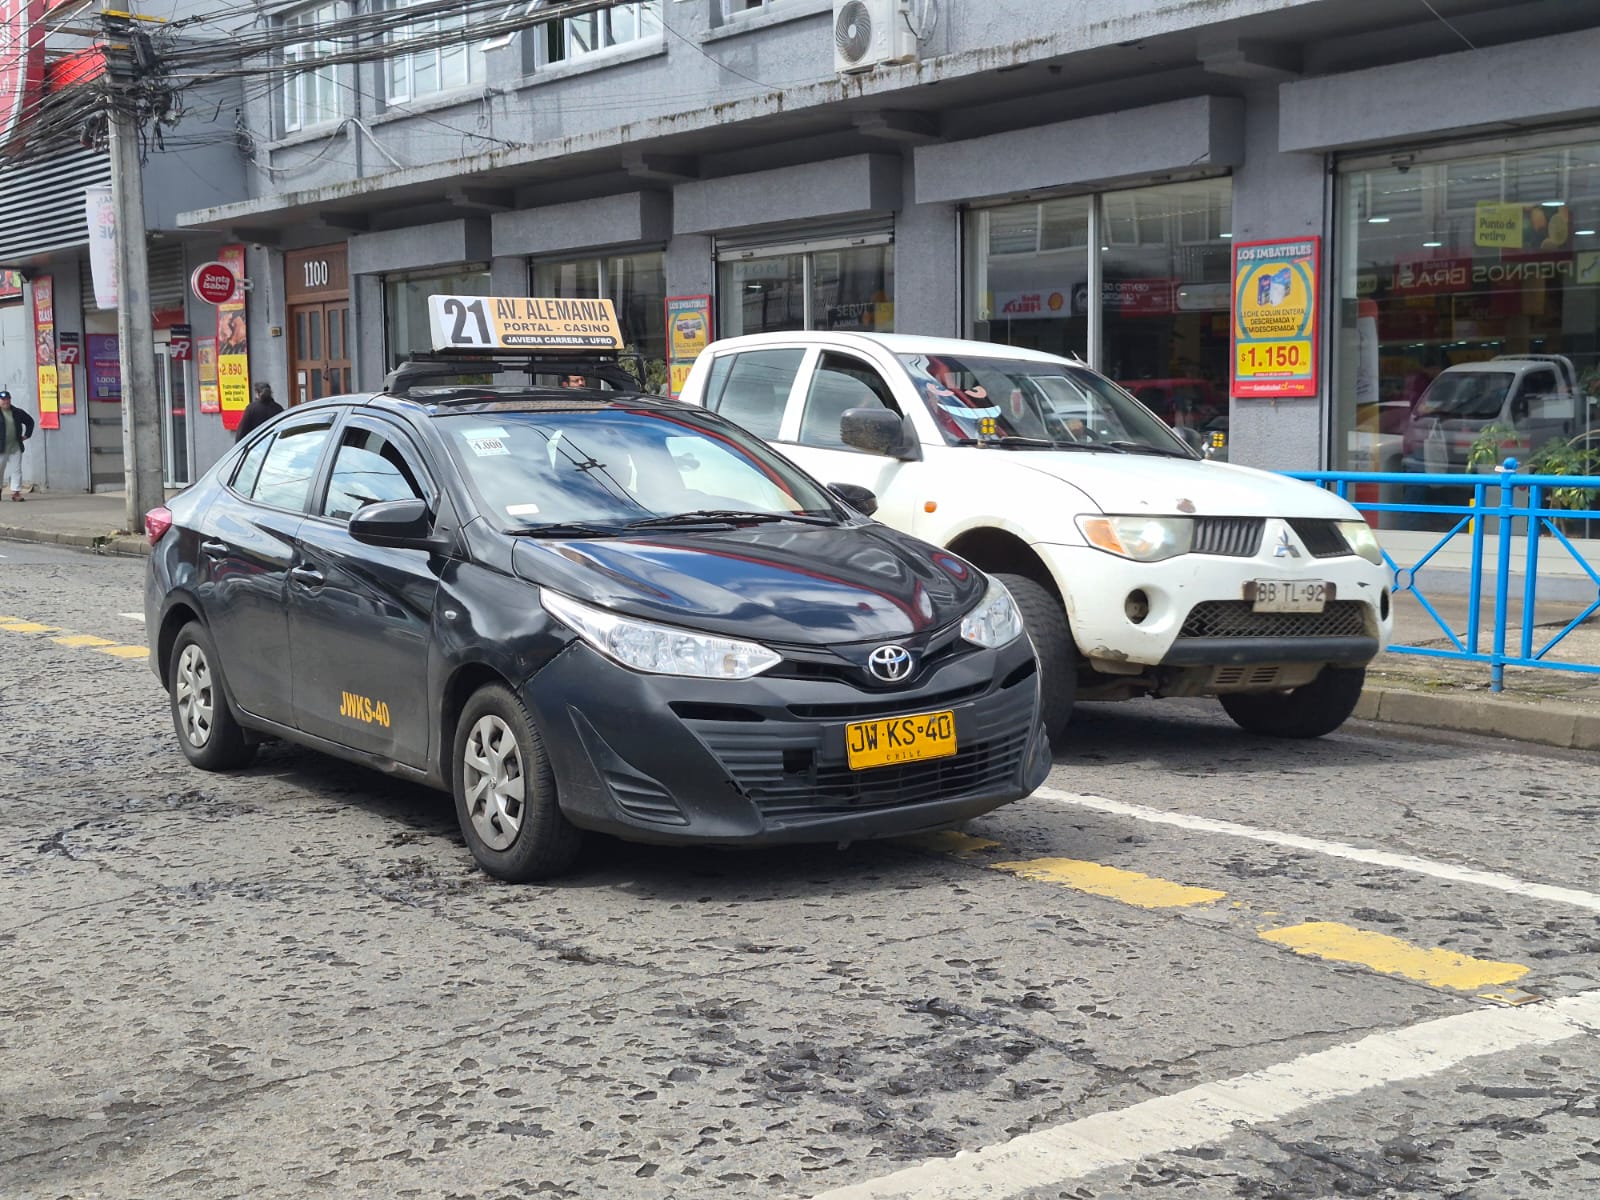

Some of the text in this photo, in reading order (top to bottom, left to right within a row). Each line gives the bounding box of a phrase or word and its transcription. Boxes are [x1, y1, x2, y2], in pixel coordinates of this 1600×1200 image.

[1237, 244, 1312, 261] LOS IMBATIBLES
[204, 273, 231, 284] Santa
[304, 260, 328, 287] 1100
[497, 299, 610, 321] AV. ALEMANIA
[443, 298, 492, 345] 21
[504, 322, 553, 332] PORTAL
[564, 323, 610, 333] CASINO
[506, 336, 541, 344] JAVIERA
[544, 336, 584, 344] CARRERA
[590, 337, 613, 345] UFRO
[886, 750, 922, 761] CHILE
